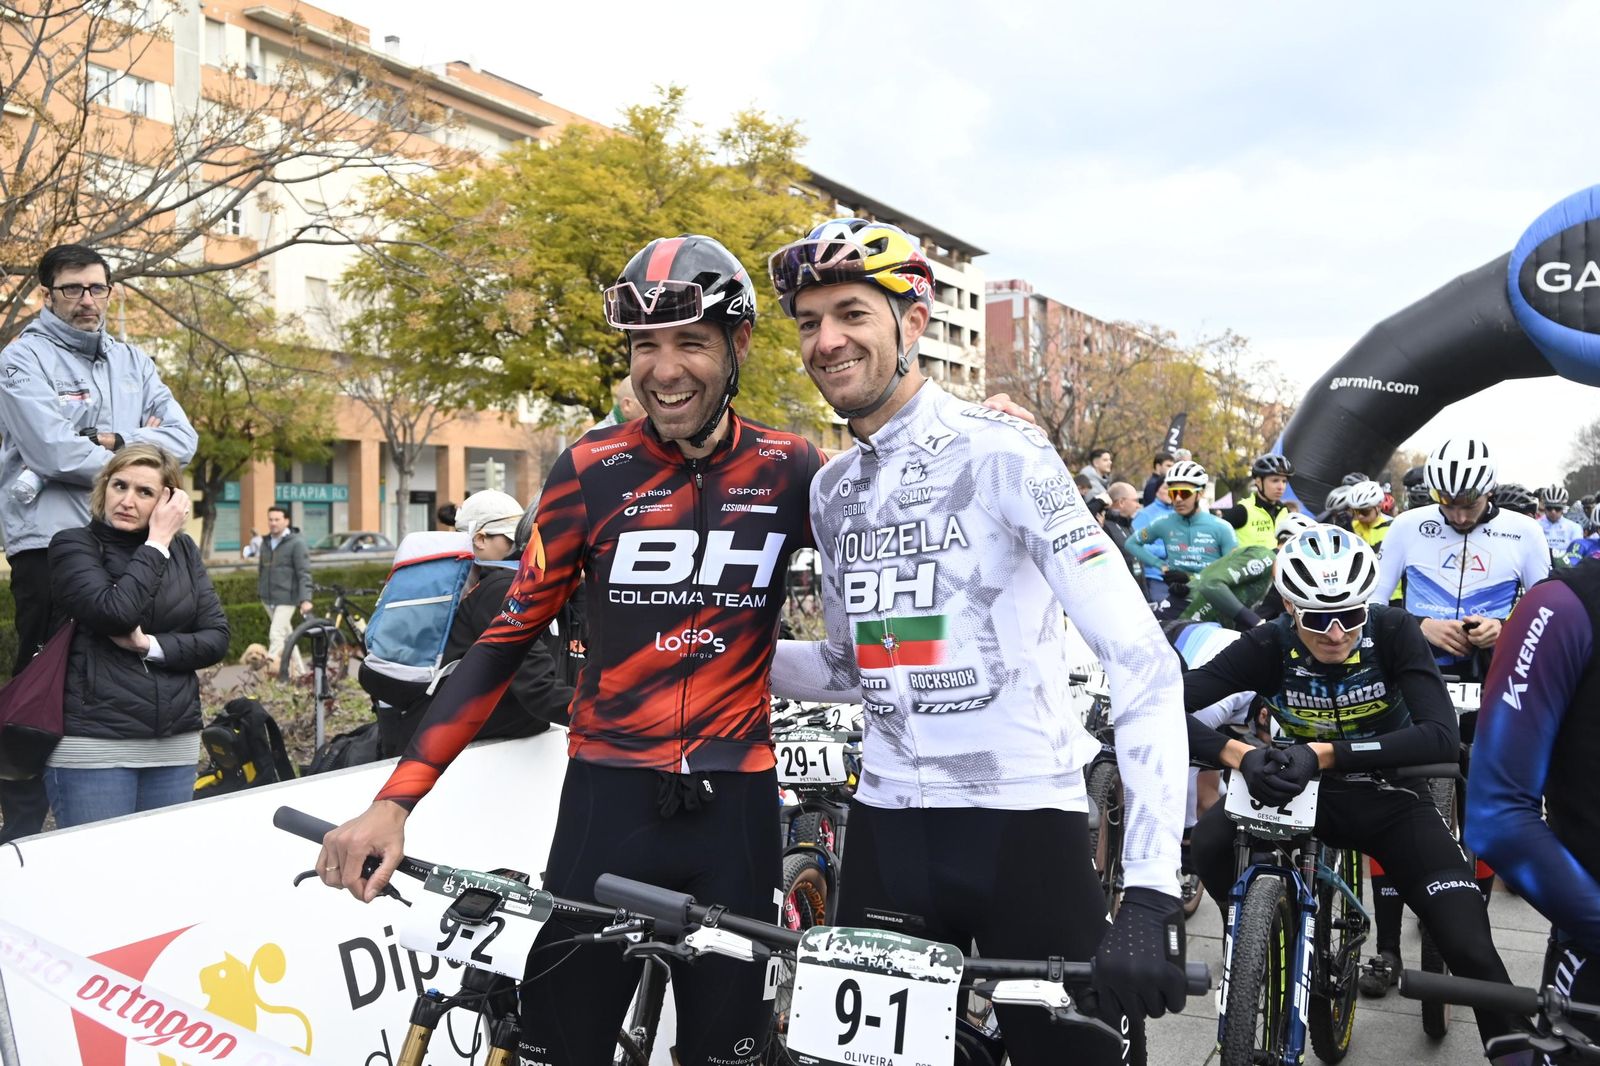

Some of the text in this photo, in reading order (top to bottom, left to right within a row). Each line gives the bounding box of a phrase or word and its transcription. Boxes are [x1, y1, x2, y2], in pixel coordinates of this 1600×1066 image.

[1536, 260, 1600, 293] GA
[1330, 376, 1419, 395] garmin.com
[591, 441, 628, 454] SHIMANO
[756, 437, 791, 446] SHIMANO
[275, 485, 327, 500] TERAPIA
[647, 488, 673, 497] Rioja
[728, 487, 772, 496] GSPORT
[720, 503, 754, 513] ASSIOMA
[843, 502, 866, 517] GOBIK
[835, 516, 969, 564] VOUZELA
[608, 529, 787, 588] BH
[844, 562, 937, 614] BH
[609, 590, 767, 607] COLOMA TEAM
[1514, 606, 1554, 678] KENDA
[910, 670, 976, 690] ROCKSHOX
[917, 693, 993, 713] TIME
[1294, 702, 1382, 719] ORBEA
[781, 746, 830, 775] 29-1
[1257, 812, 1281, 822] GESCHE
[552, 902, 580, 913] GEMINI
[436, 916, 506, 965] 9-2
[76, 974, 238, 1060] octagon
[835, 978, 909, 1056] 9-1
[844, 1050, 894, 1066] OLIVEIRA
